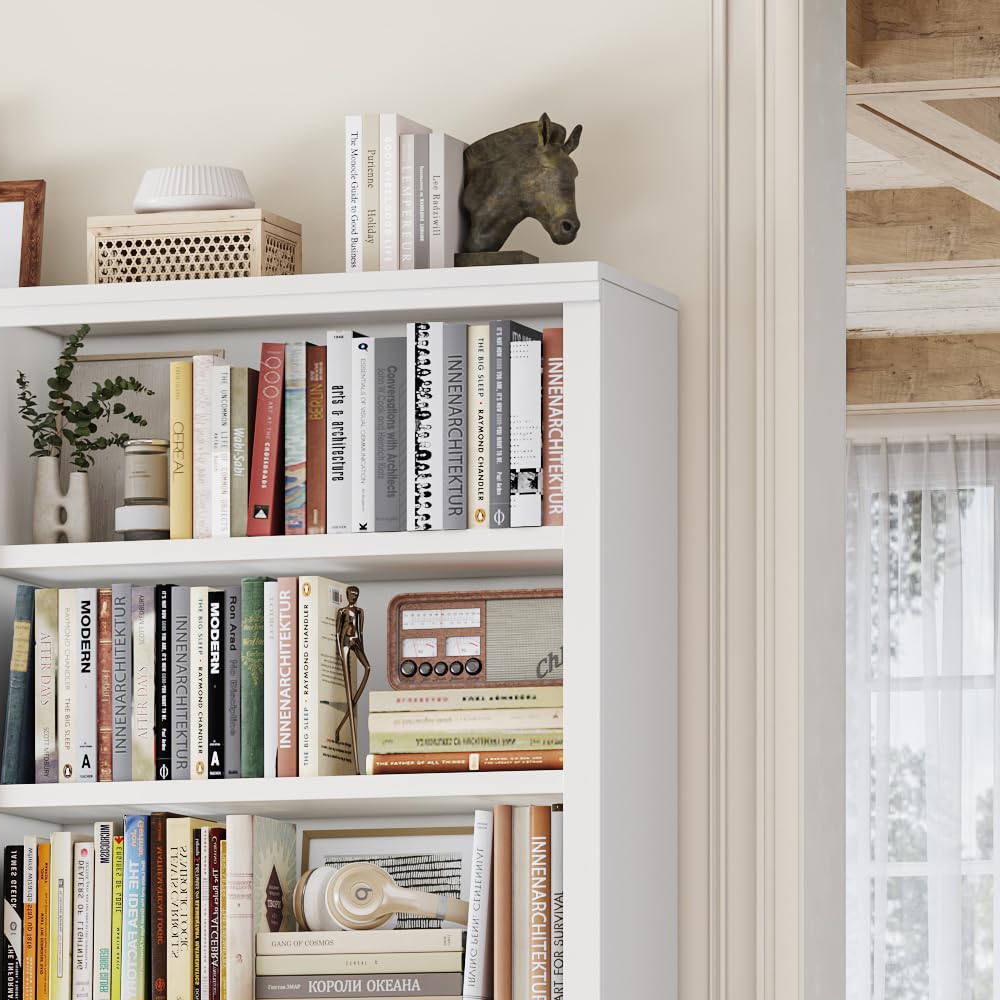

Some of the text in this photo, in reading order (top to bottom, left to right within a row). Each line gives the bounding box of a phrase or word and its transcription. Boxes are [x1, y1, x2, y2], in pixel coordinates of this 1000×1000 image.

[365, 210, 376, 244] Holiday
[332, 385, 343, 404] arts
[173, 421, 185, 478] CEREAL
[233, 427, 245, 477] Wabi-Sabi
[332, 421, 347, 481] architecture
[448, 355, 463, 516] INNENARCHITEKTUR
[547, 357, 563, 515] INNENARCHITEKTUR
[81, 600, 91, 673] MODERN
[210, 602, 220, 674] MODERN
[230, 596, 238, 651] Ron Arad
[114, 596, 127, 753] INNENARCHITEKTUR
[176, 616, 188, 769] INNENARCHITEKTUR
[280, 589, 291, 748] INNENARCHITEKTUR
[553, 891, 564, 947] SURVIVAL
[308, 979, 421, 993] КОРОЛИ ОКЕАНА
[554, 951, 564, 976] FOR
